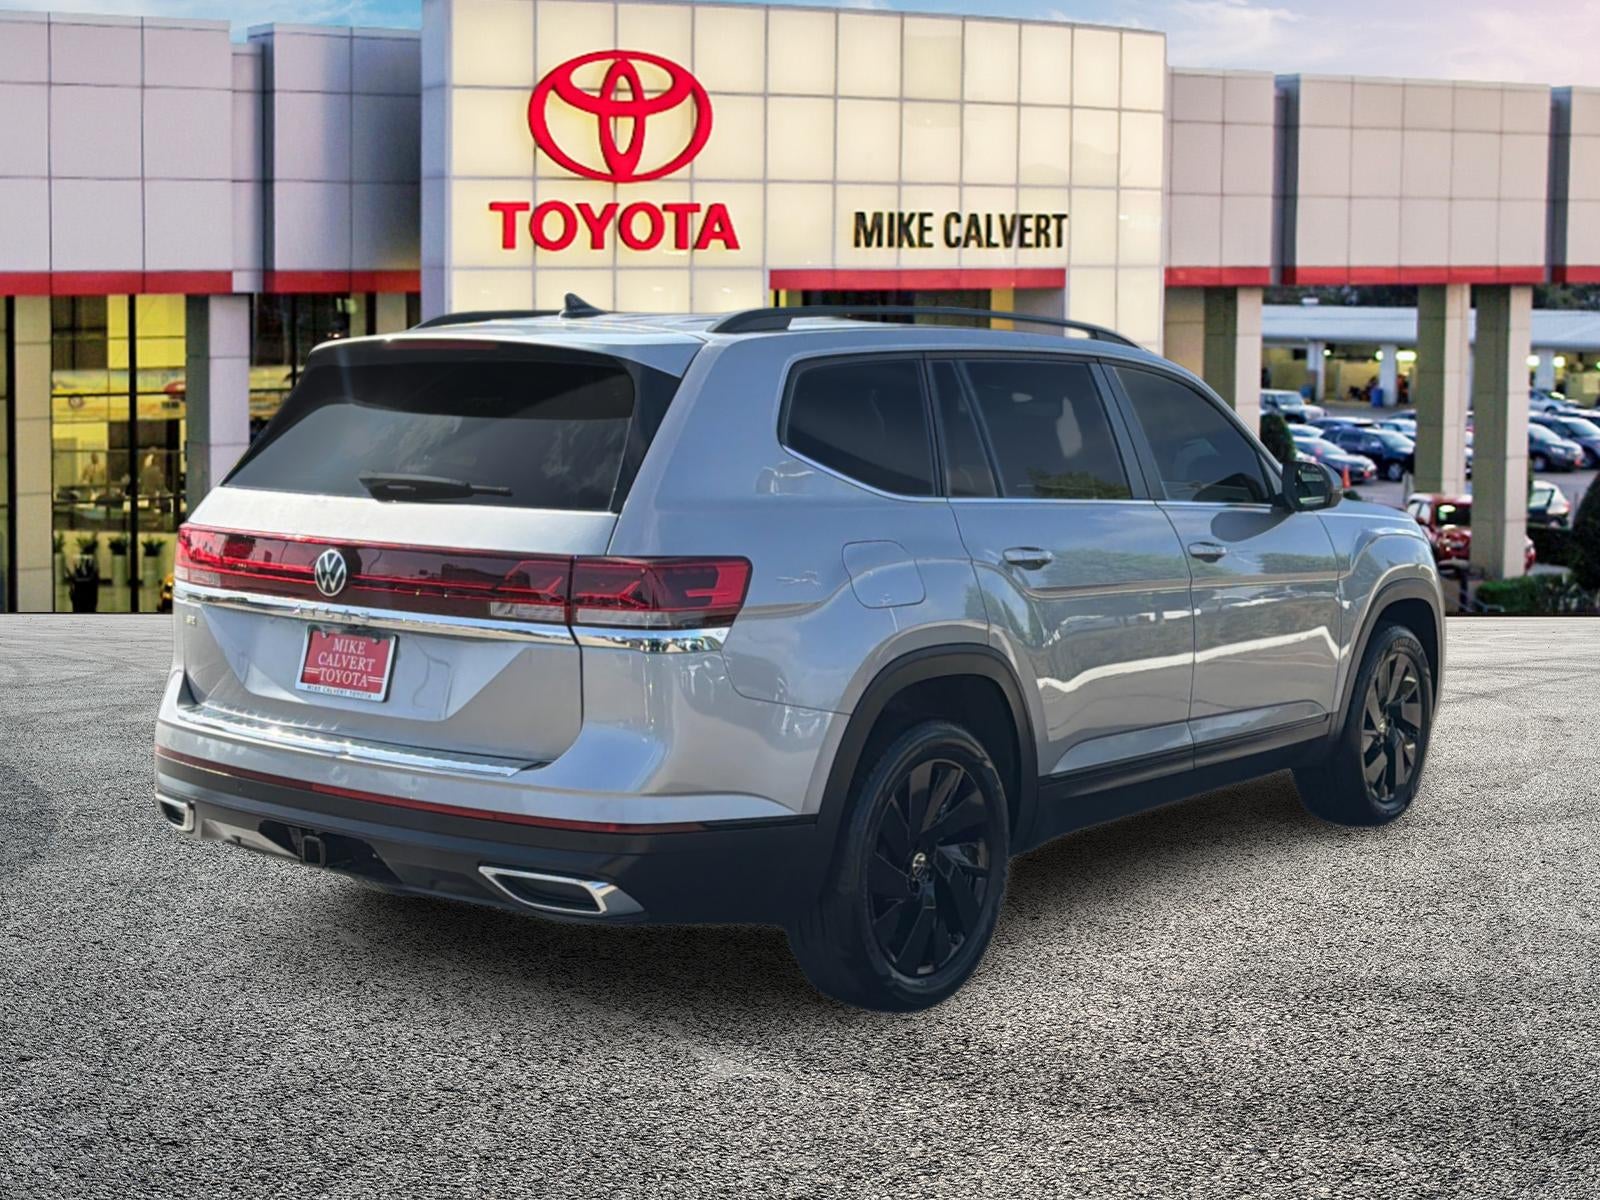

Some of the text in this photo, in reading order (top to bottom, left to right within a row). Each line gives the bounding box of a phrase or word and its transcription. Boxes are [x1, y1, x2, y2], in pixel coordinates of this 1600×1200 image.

[489, 200, 740, 251] TOYOTA
[853, 211, 1068, 249] MIKE CALVERT
[333, 638, 366, 655] MIKE
[318, 652, 376, 672] CALVERT
[318, 667, 369, 687] TOYOTA
